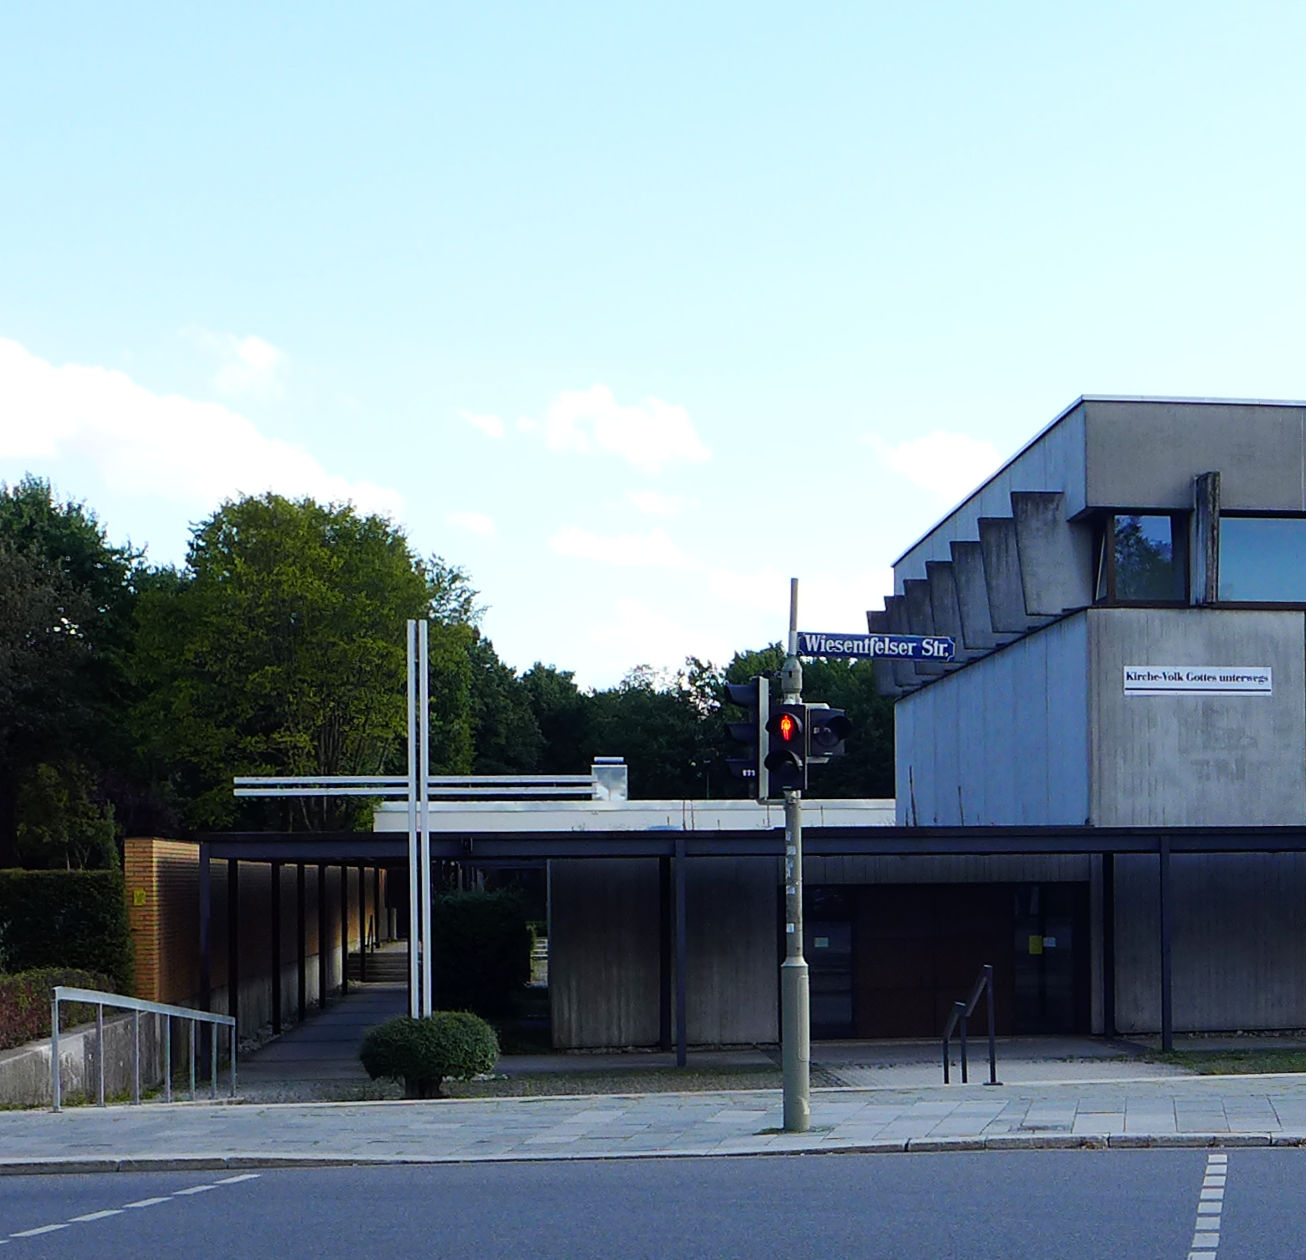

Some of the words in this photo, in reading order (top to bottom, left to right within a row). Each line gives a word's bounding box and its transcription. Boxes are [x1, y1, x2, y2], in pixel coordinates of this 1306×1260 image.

[804, 633, 917, 657] Wiesentfelser
[921, 639, 949, 657] Str.
[1126, 671, 1184, 681] Kirche-Volk
[1186, 672, 1217, 682] Gottes
[1219, 674, 1269, 685] unterwegs
